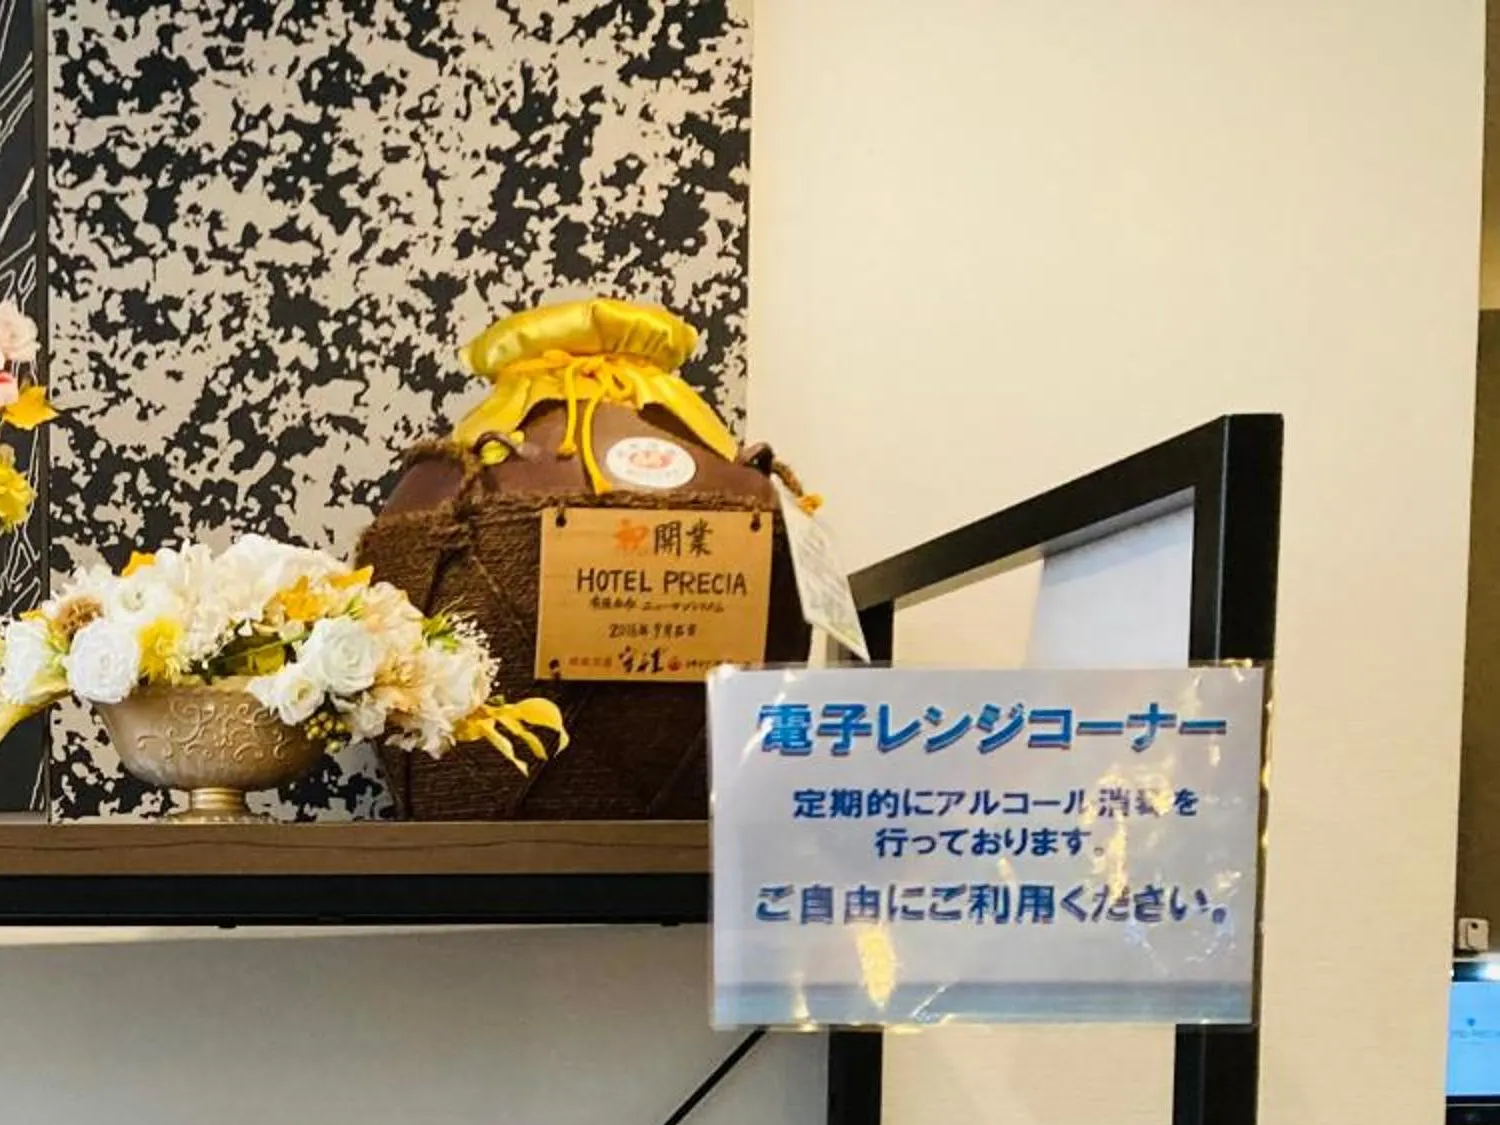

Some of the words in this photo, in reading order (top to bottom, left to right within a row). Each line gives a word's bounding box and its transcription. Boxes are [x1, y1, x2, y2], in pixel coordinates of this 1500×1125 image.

[577, 568, 652, 594] HOTEL
[664, 571, 748, 596] PRECIA
[758, 702, 1227, 755] 電子レンジコーナー
[875, 827, 1107, 857] 行っております。
[756, 884, 1228, 925] ご自由にご利用ください。
